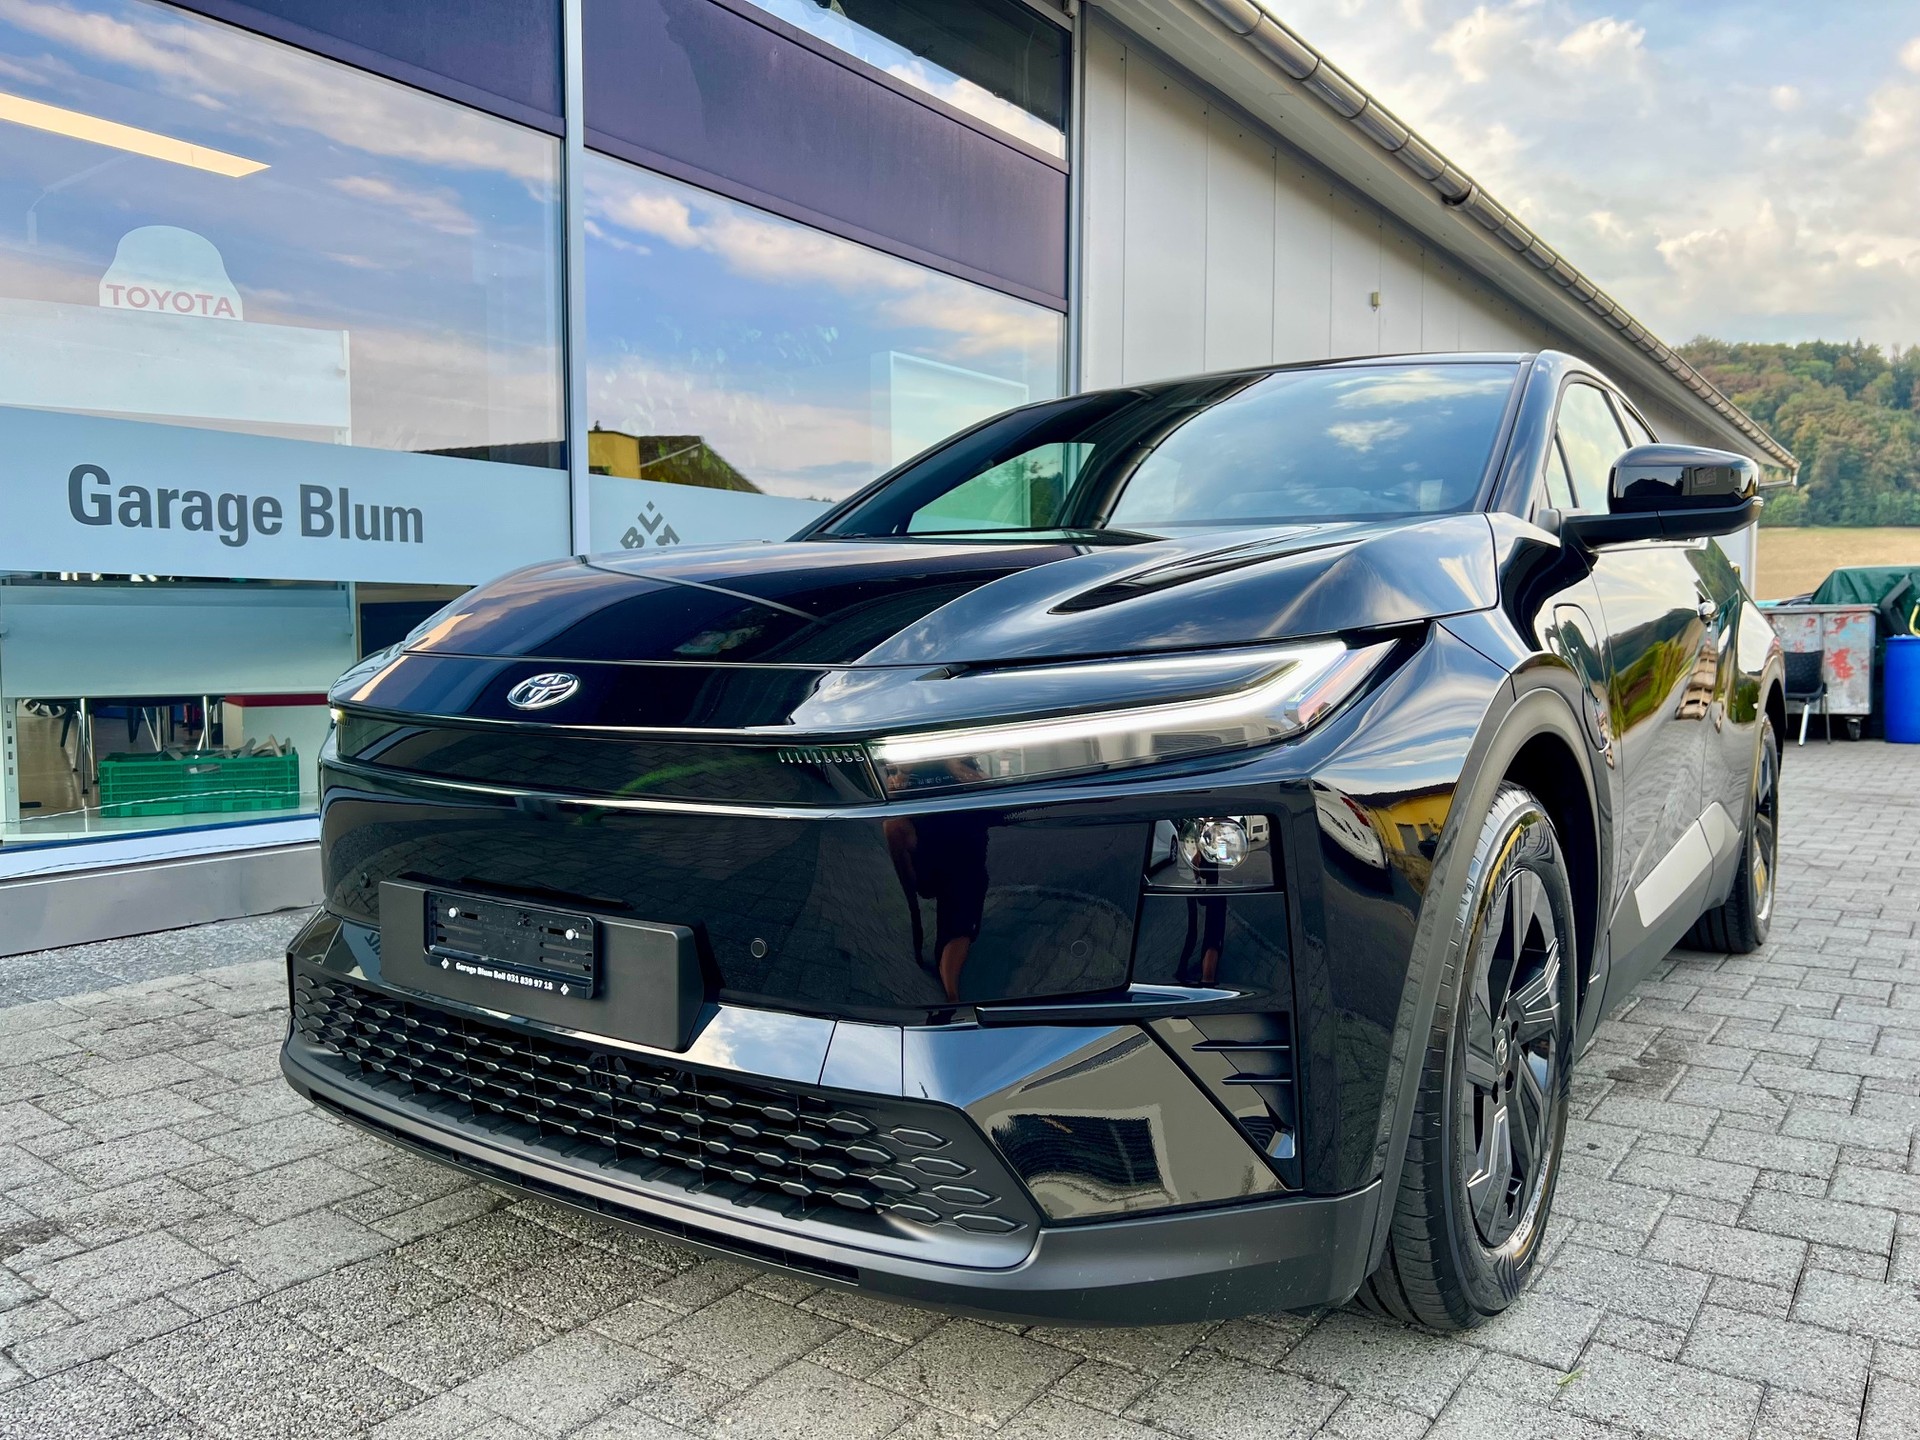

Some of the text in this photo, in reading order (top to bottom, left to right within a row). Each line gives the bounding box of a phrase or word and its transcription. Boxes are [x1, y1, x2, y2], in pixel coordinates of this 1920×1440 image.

[106, 284, 236, 318] TOYOTA
[68, 463, 424, 547] Garage Blum
[456, 963, 476, 974] Garage
[477, 967, 493, 977] Blum
[506, 974, 519, 983] 031
[520, 976, 533, 986] 839
[534, 979, 543, 988] 97
[544, 981, 553, 990] 18
